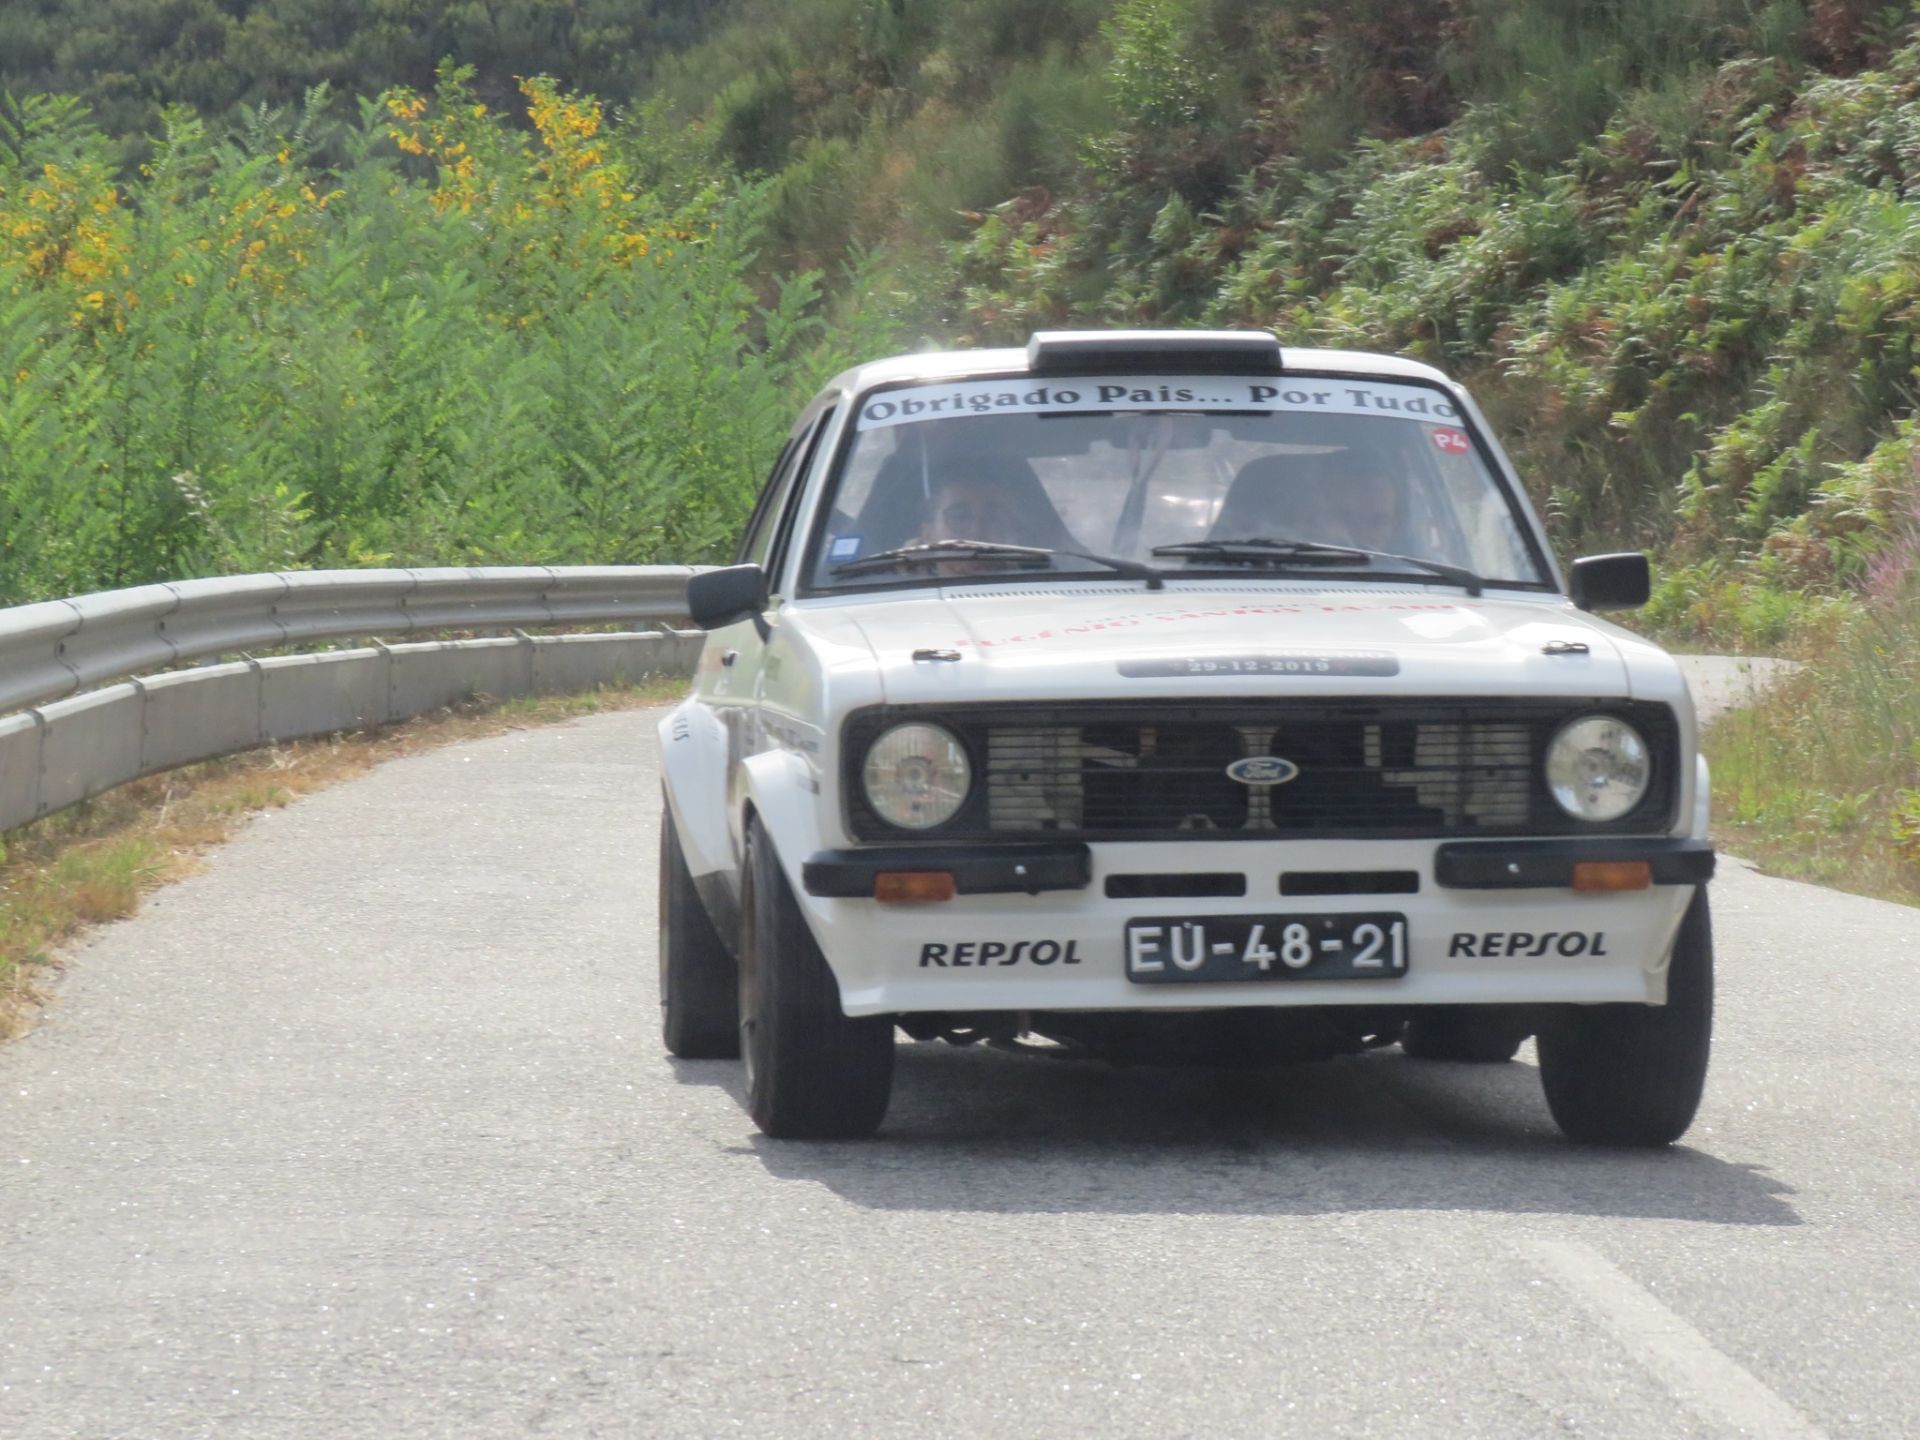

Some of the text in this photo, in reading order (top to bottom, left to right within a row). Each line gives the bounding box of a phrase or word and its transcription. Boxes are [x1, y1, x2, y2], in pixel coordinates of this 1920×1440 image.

[863, 387, 1081, 421] Obrigado
[1248, 385, 1332, 405] Por
[1345, 389, 1459, 418] Tudo
[1432, 431, 1467, 448] P4
[1188, 659, 1331, 672] 29-12-2019
[918, 939, 1083, 968] REPSOL
[1128, 921, 1405, 973] EU-48-21
[1447, 931, 1608, 958] REPSOL
